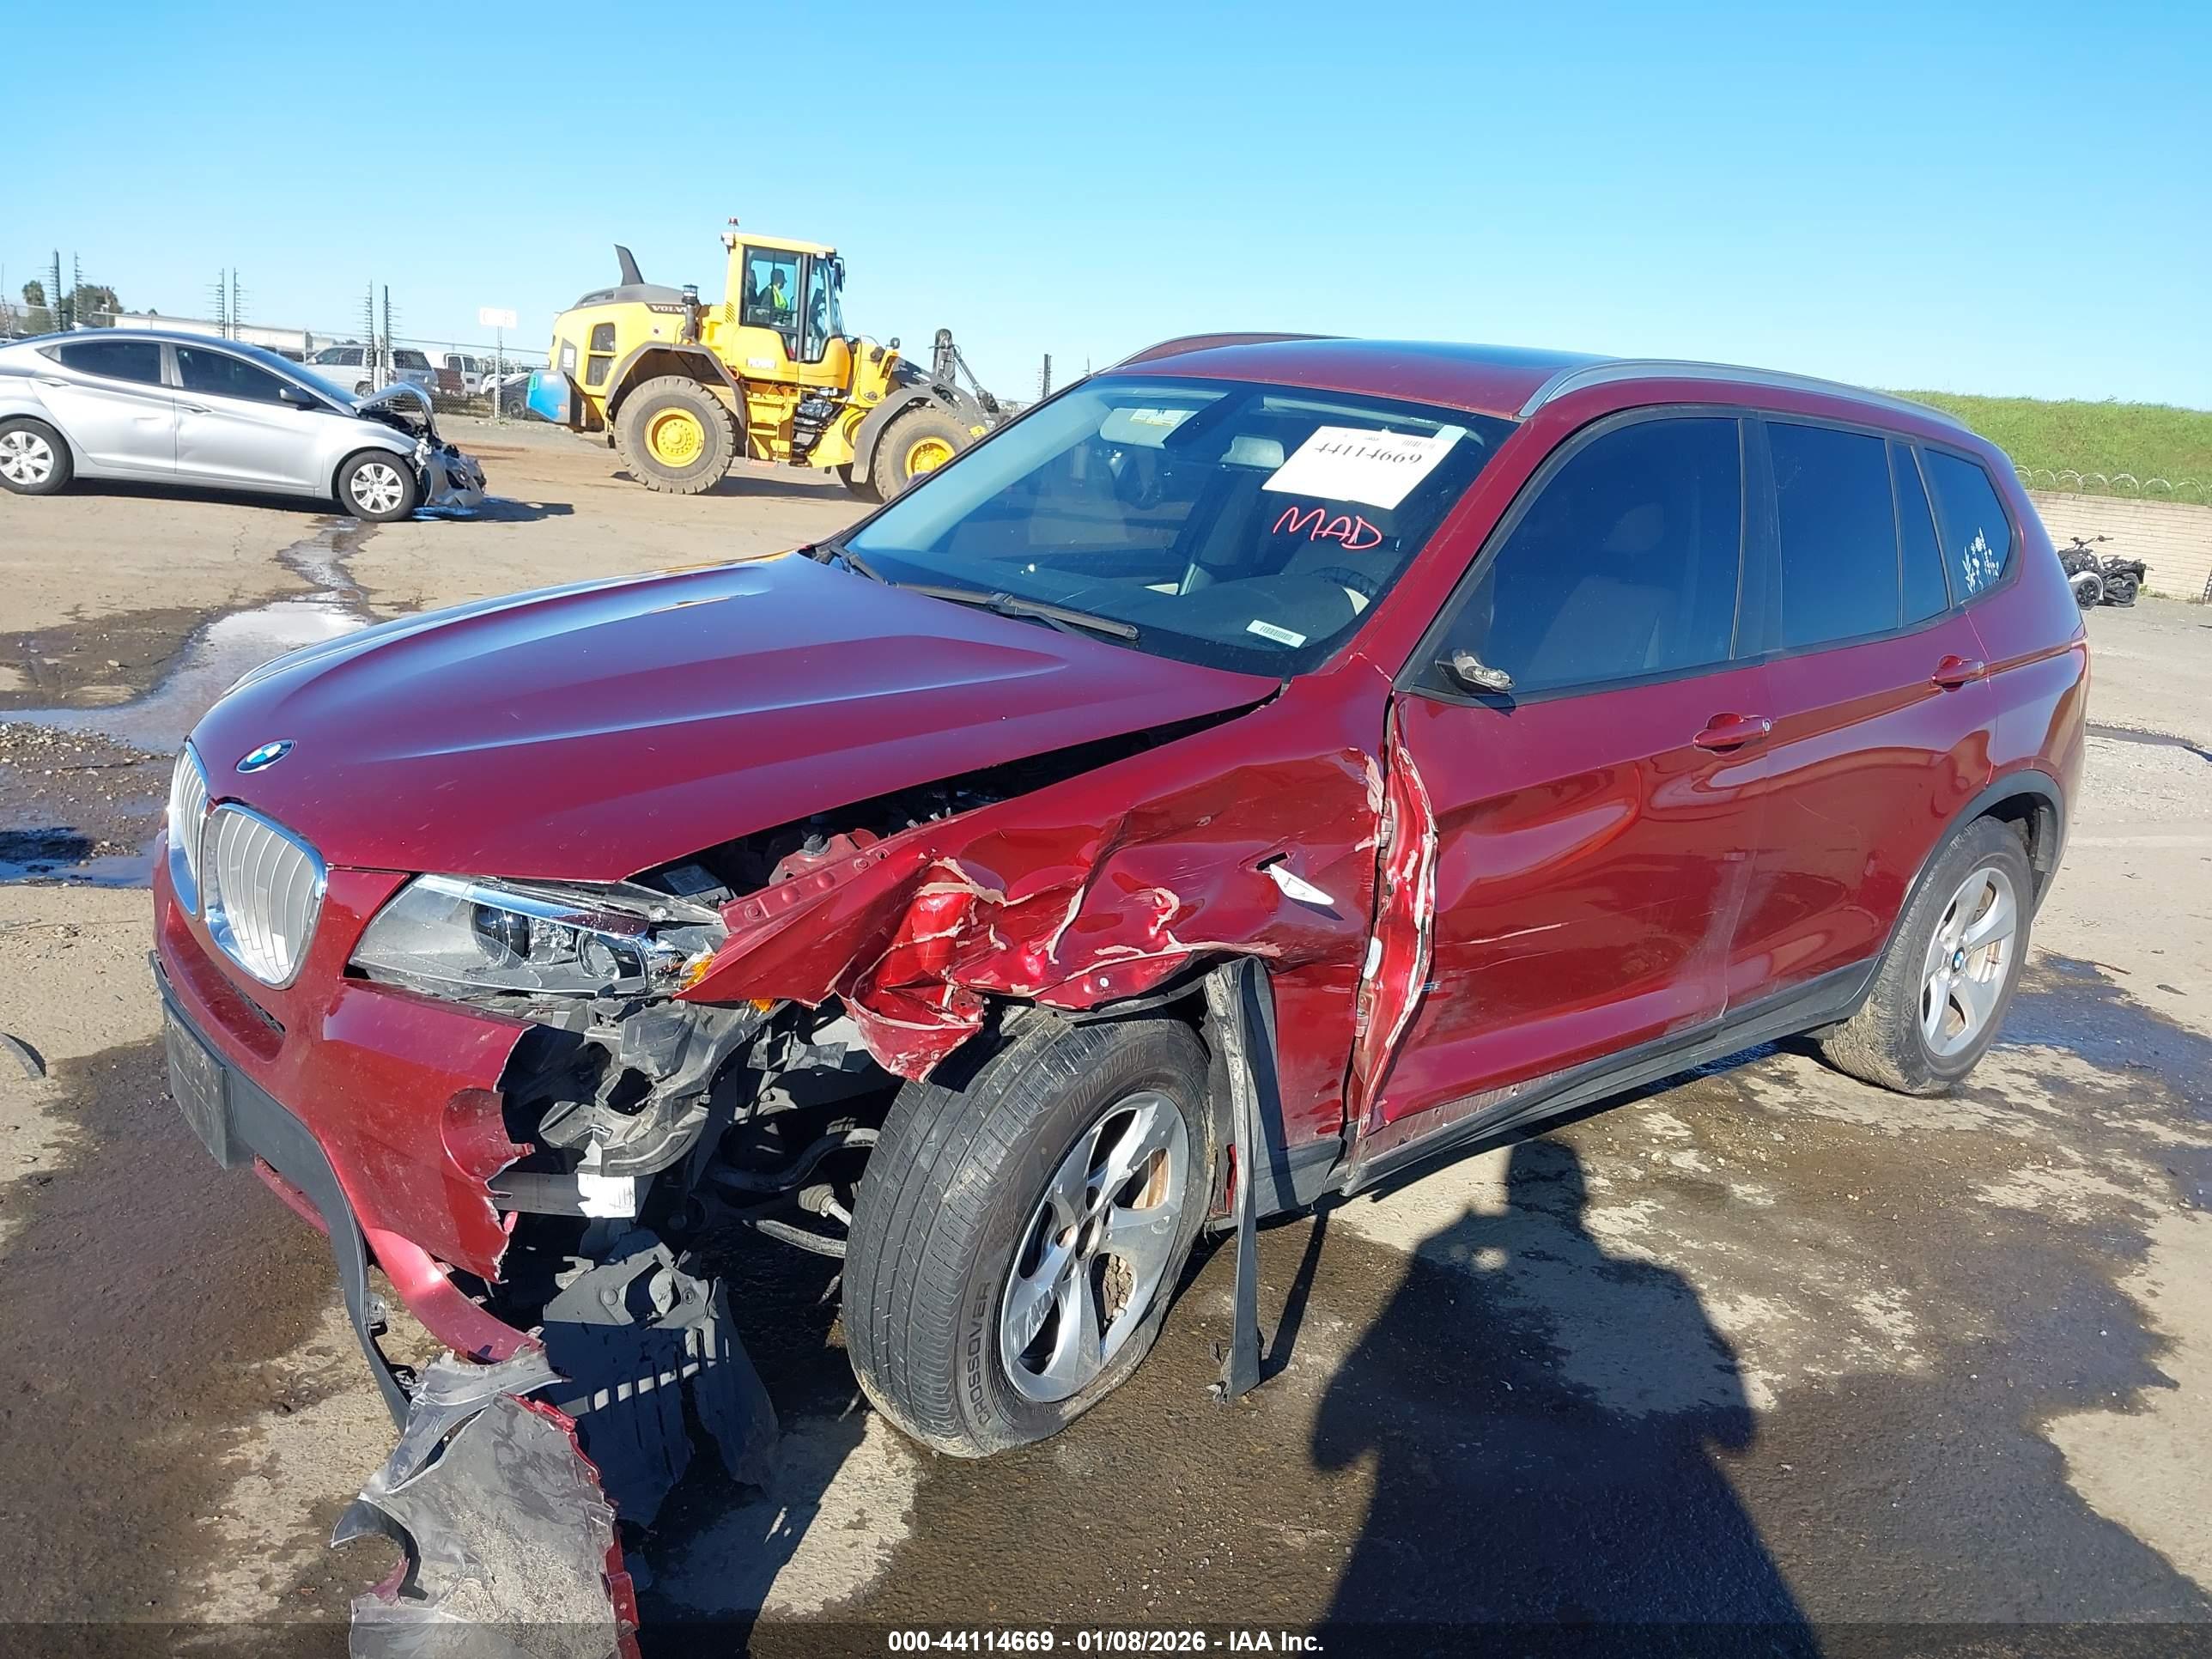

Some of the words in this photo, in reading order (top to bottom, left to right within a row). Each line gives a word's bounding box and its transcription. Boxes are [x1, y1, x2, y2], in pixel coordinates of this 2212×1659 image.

[1315, 442, 1423, 464] 44114669
[1273, 507, 1382, 549] MAD
[967, 1281, 992, 1425] CROSSOVER
